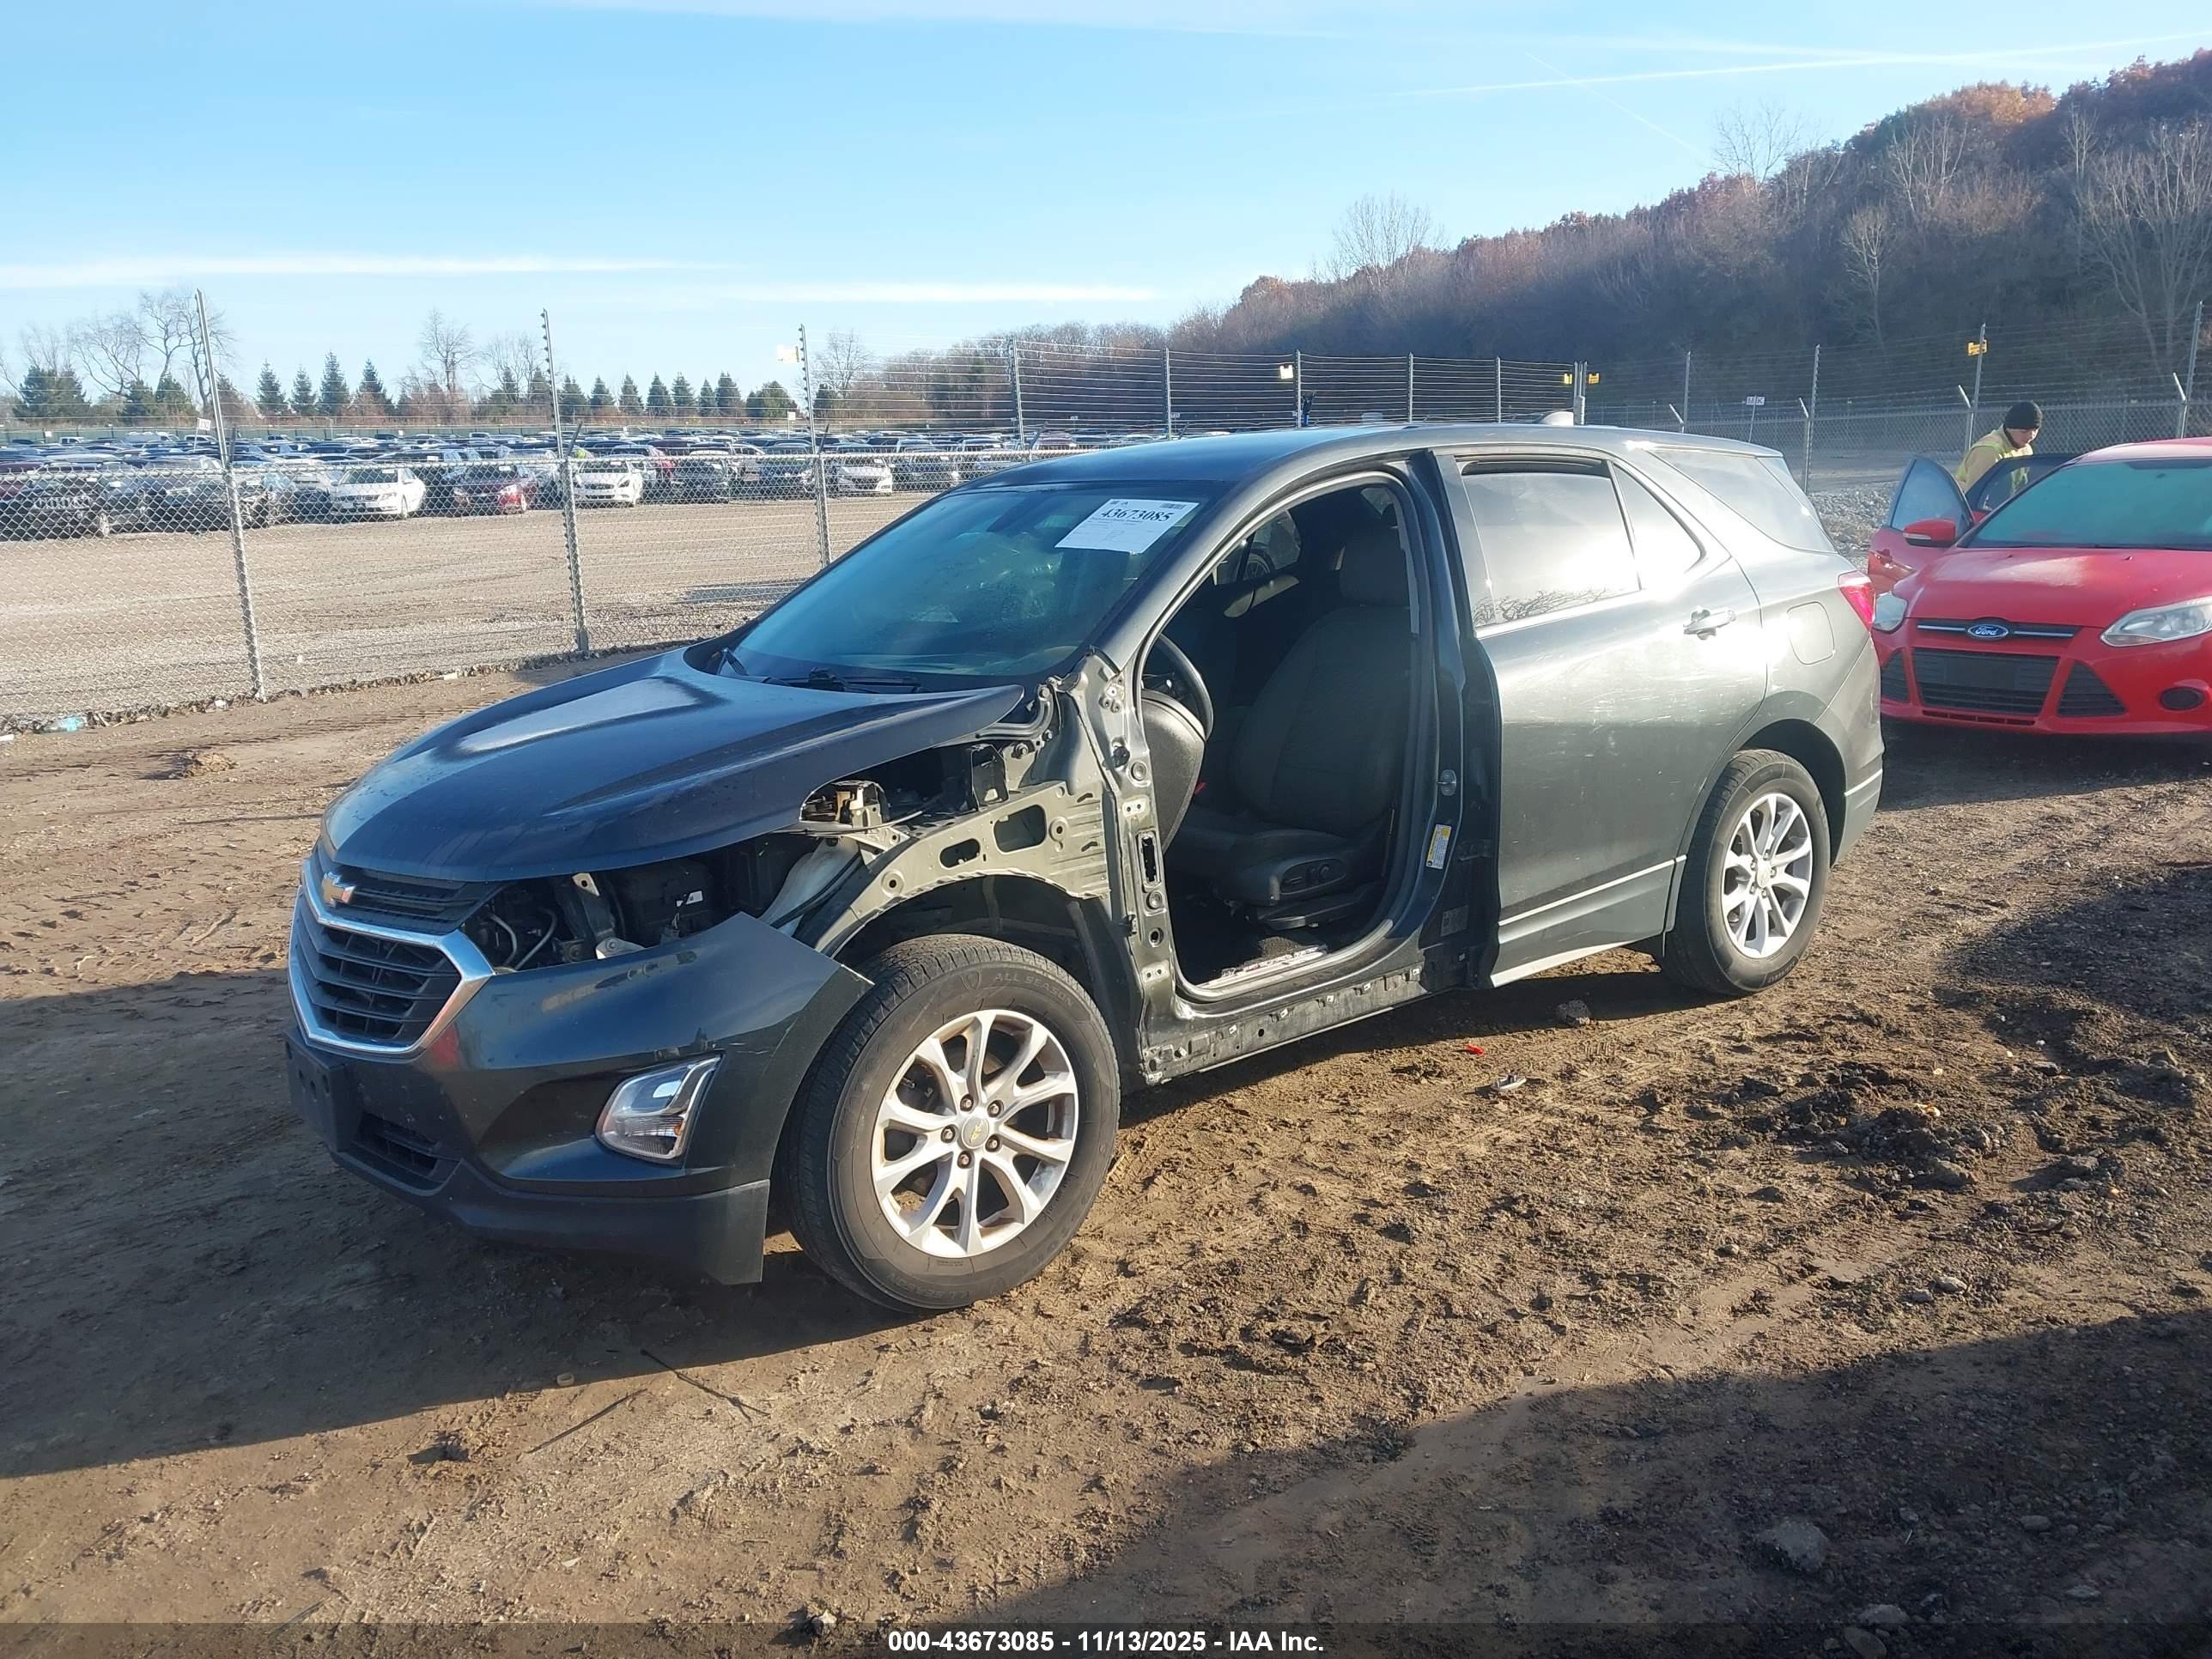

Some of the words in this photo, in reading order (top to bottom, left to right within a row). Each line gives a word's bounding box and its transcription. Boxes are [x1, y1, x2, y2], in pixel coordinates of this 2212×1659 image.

[1101, 508, 1175, 522] 43673085
[1974, 625, 2000, 635] Ford
[994, 971, 1019, 983] ALL
[1024, 975, 1074, 1007] SEASON
